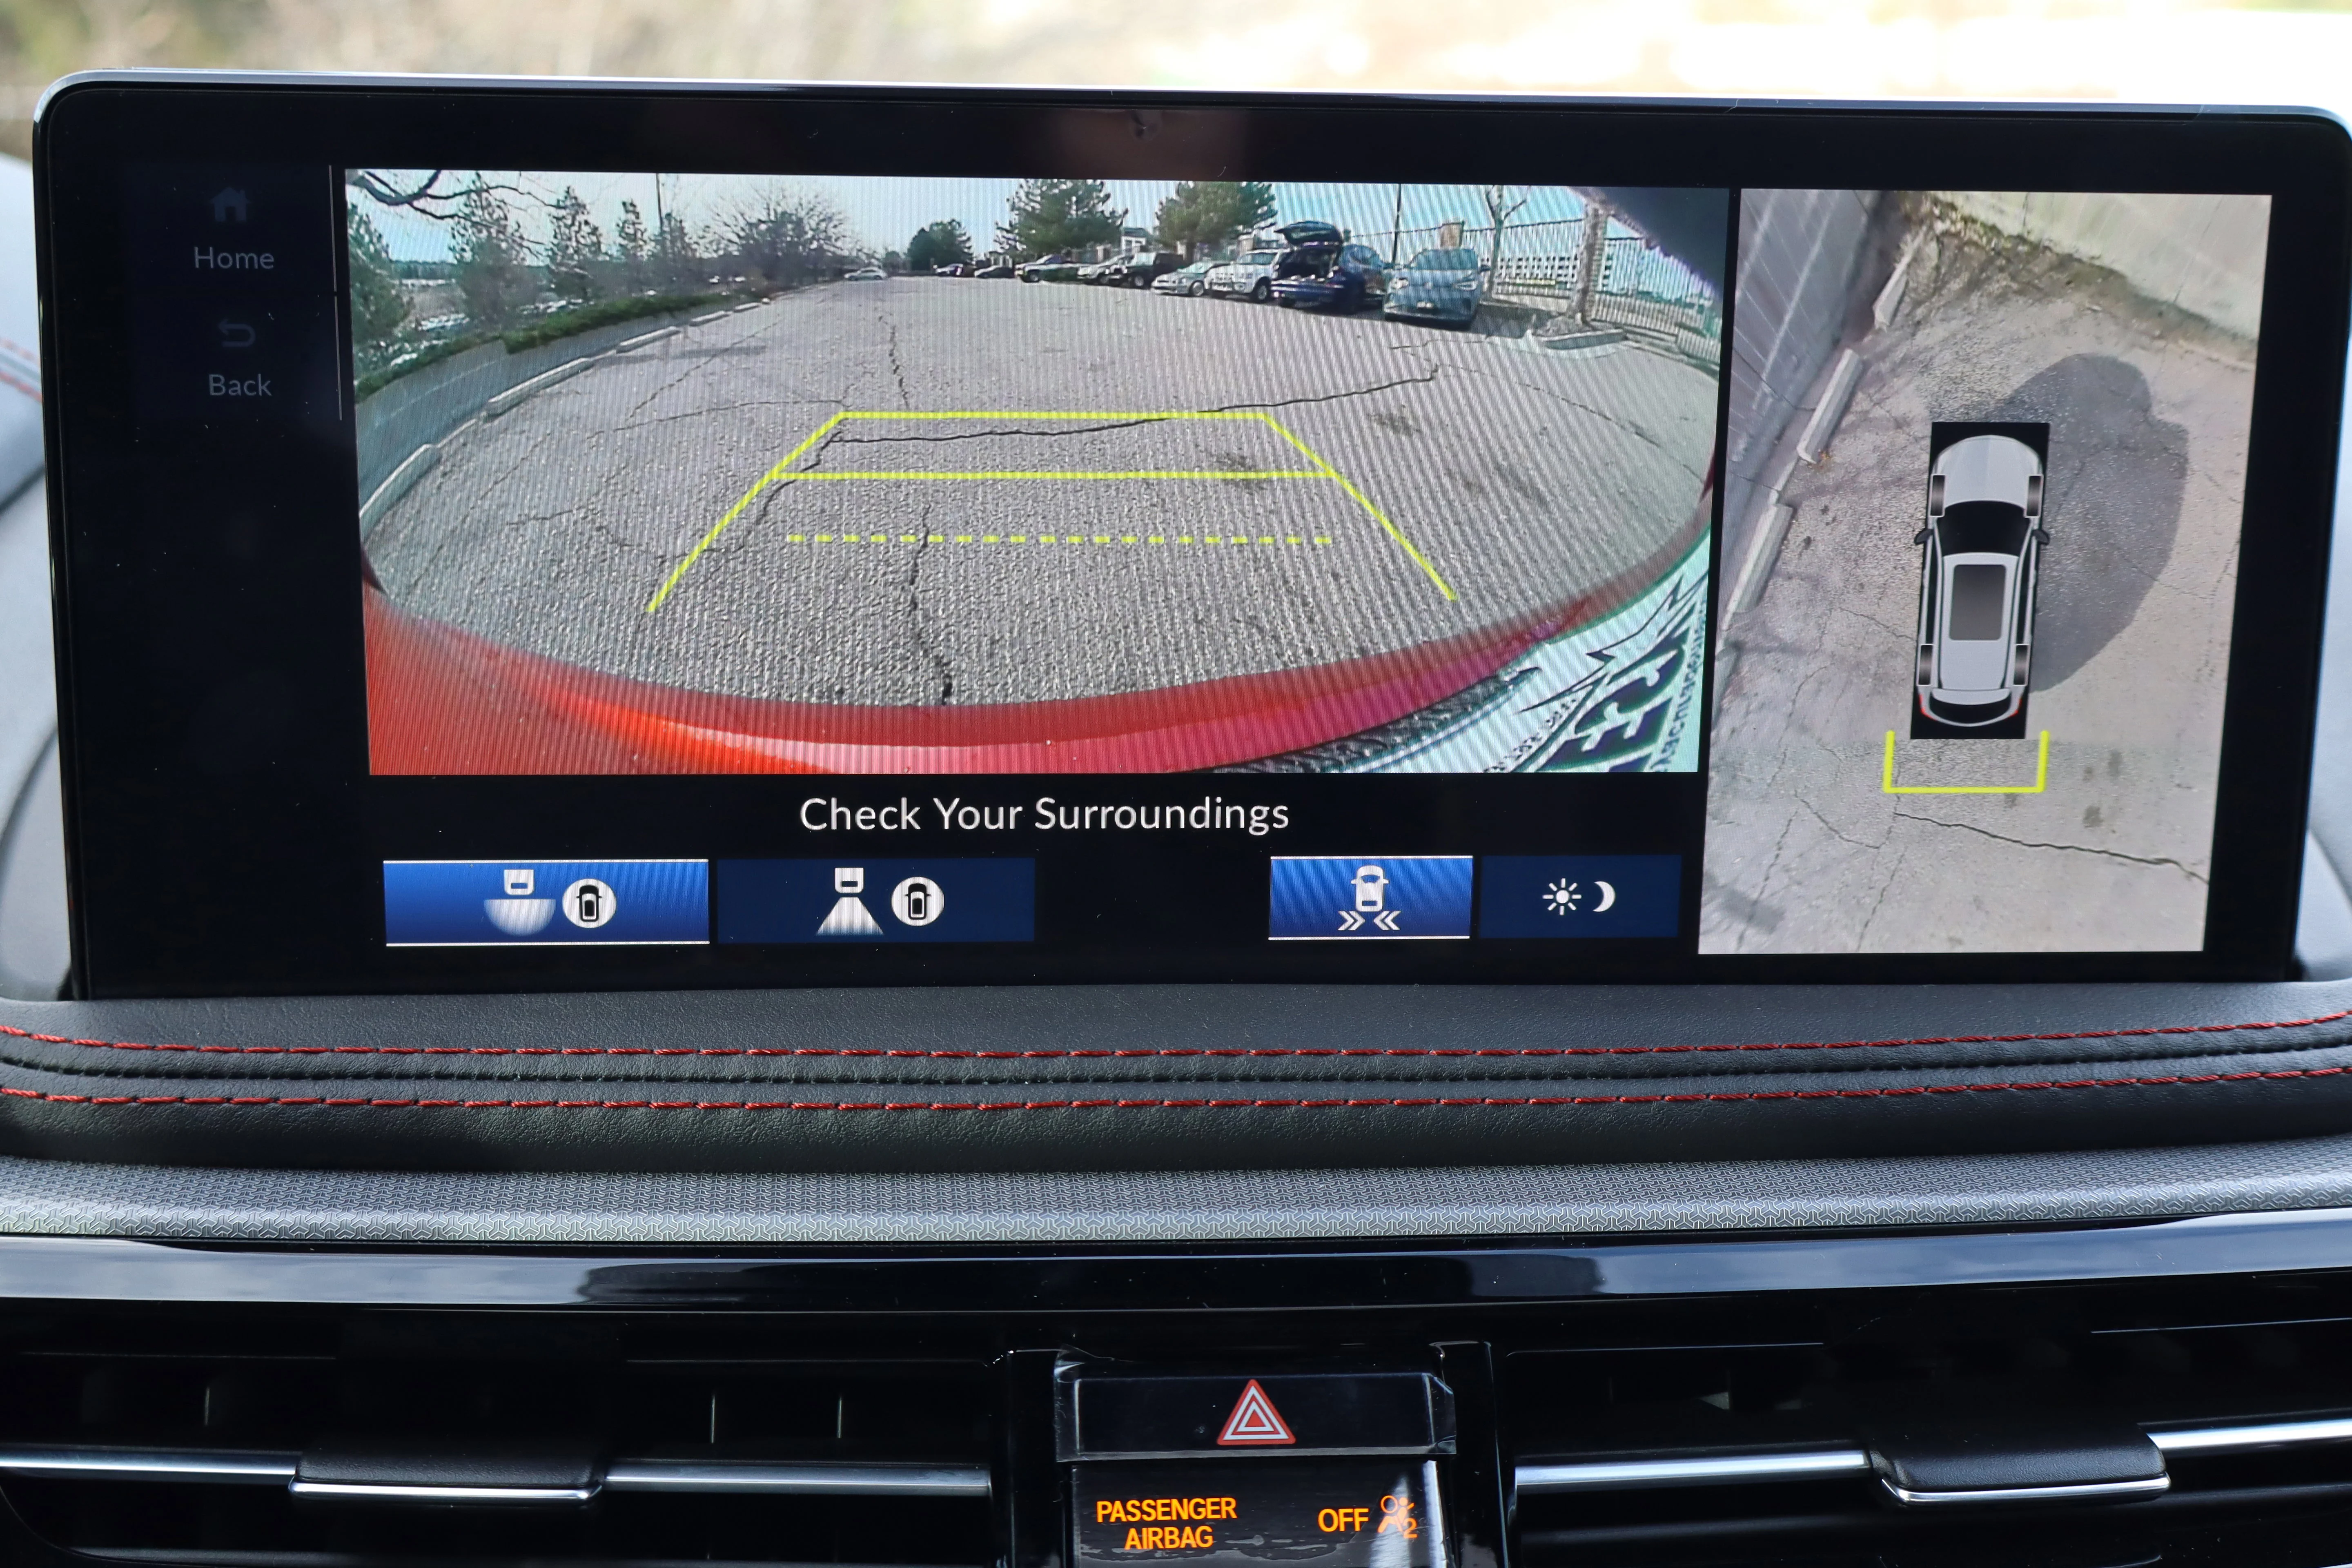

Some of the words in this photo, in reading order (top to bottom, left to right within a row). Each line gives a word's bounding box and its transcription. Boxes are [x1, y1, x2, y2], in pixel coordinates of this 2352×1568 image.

[195, 247, 274, 269] Home
[209, 374, 271, 396] Back
[800, 797, 920, 830] Check
[934, 798, 1022, 829] Your
[1035, 797, 1288, 835] Surroundings
[1097, 1497, 1237, 1522] PASSENGER
[1318, 1508, 1369, 1532] OFF
[1125, 1526, 1213, 1550] AIRBAG
